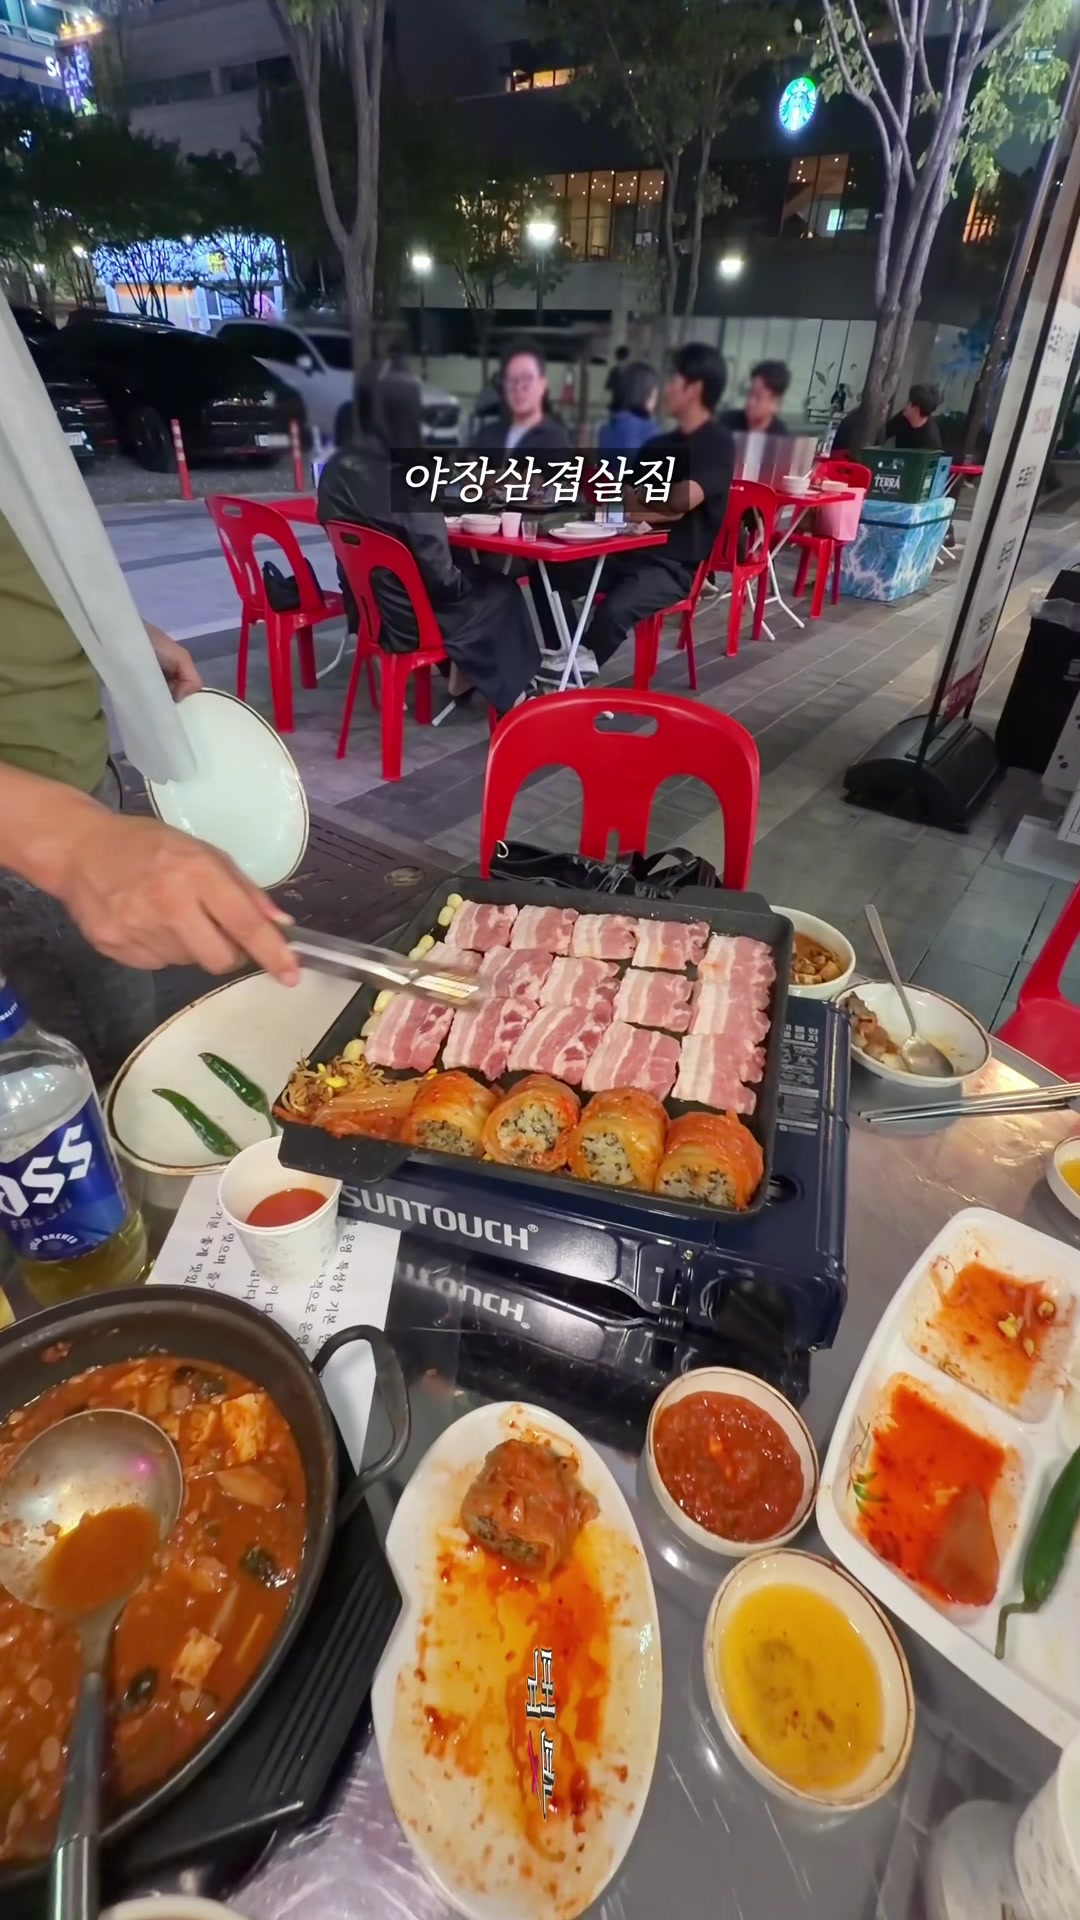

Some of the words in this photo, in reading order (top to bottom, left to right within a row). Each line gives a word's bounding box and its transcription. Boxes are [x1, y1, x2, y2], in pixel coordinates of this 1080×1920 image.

[874, 473, 901, 490] TERRA
[330, 1260, 349, 1294] 특성상
[322, 1301, 339, 1325] 기본
